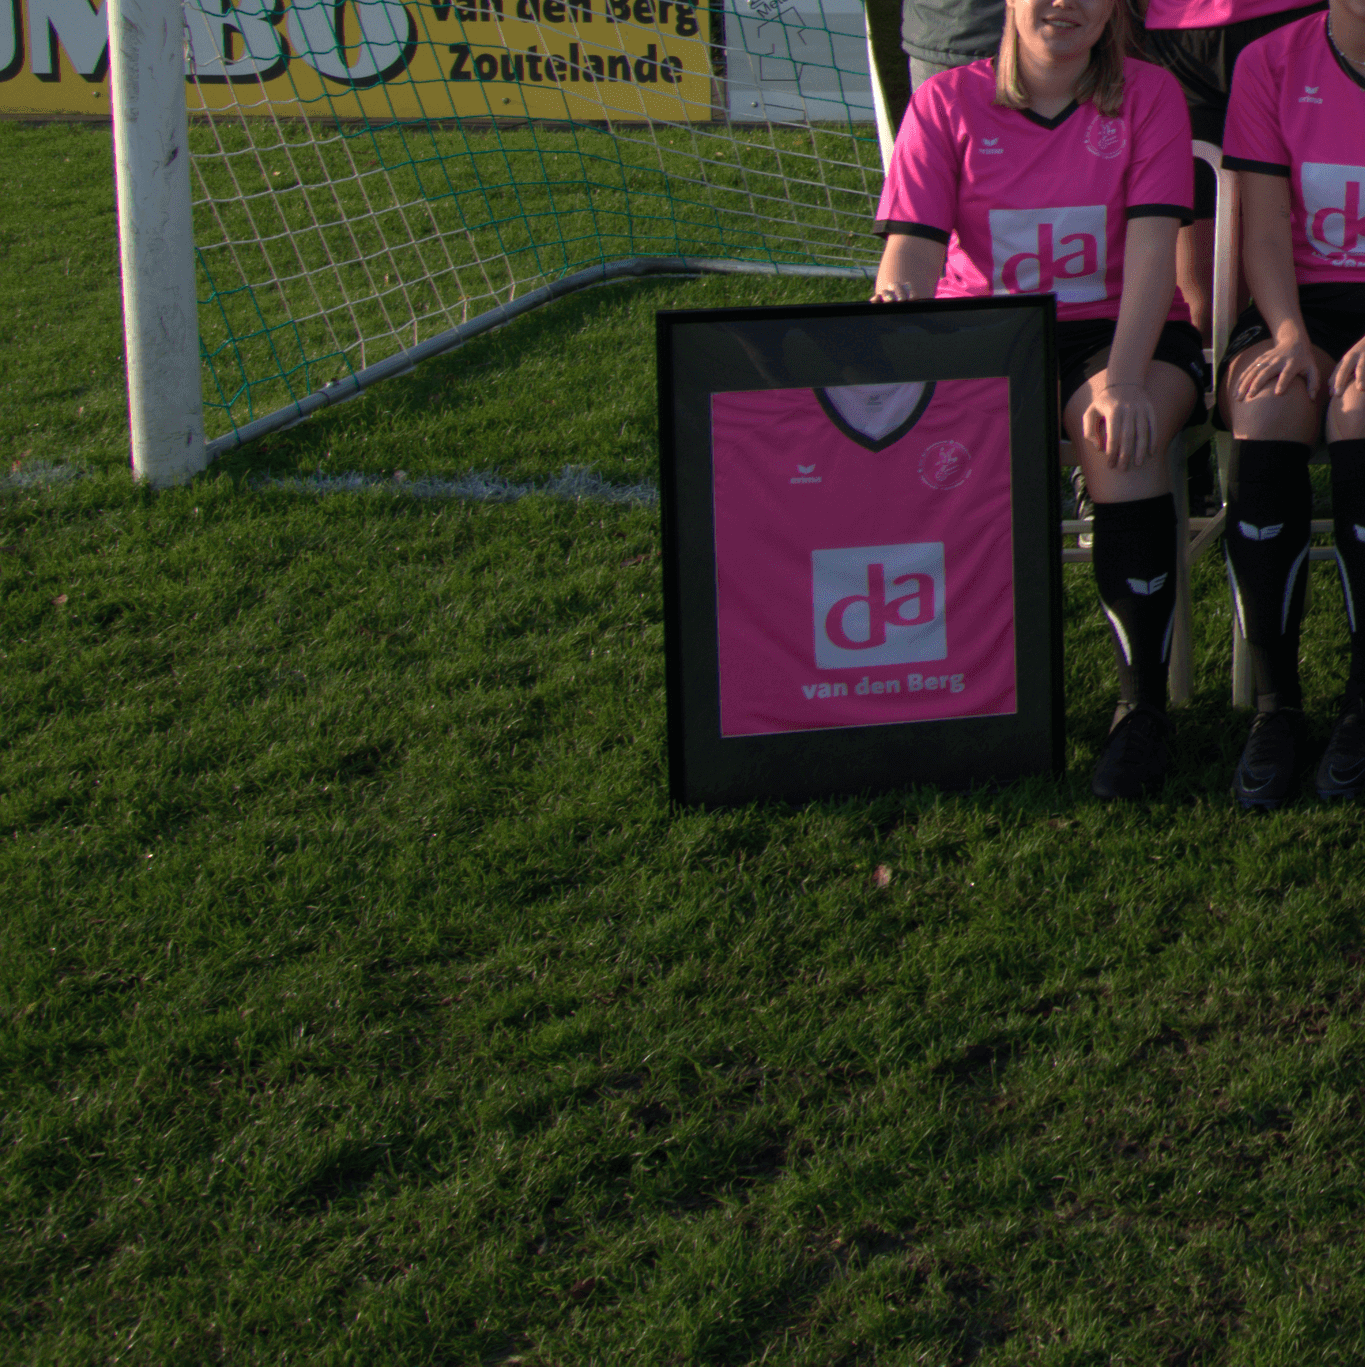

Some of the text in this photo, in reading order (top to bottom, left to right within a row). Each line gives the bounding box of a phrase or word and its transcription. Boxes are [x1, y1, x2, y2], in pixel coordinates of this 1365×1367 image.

[449, 43, 684, 83] Zoutelande
[1002, 223, 1097, 293] da
[825, 563, 936, 651] da
[802, 671, 966, 700] van den Berg
